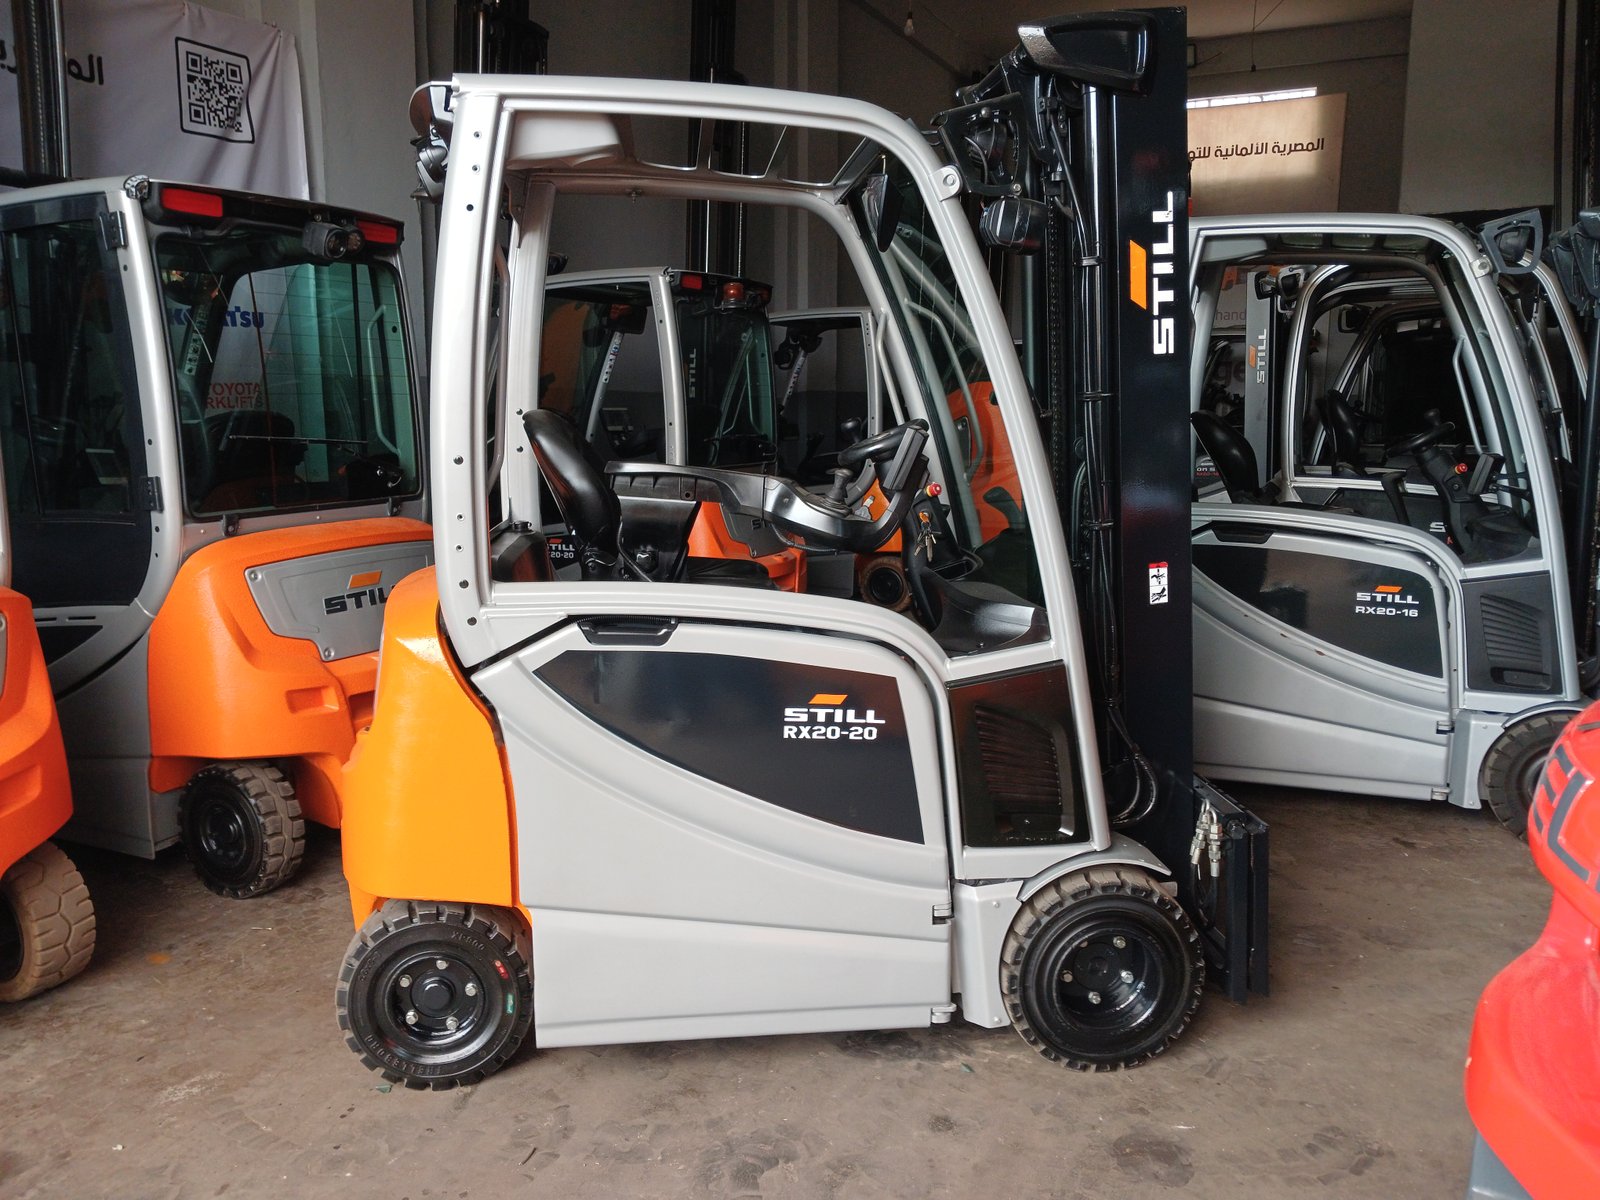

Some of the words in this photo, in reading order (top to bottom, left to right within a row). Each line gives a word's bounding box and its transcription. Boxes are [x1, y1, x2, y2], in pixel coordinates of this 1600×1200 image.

[1187, 146, 1211, 162] للتو
[1214, 142, 1269, 160] الألمانية
[1272, 138, 1325, 156] المصرية
[1152, 191, 1174, 354] STILL
[1257, 328, 1267, 383] STILL
[688, 348, 697, 398] STILL
[209, 382, 264, 396] OYOTA
[206, 396, 265, 409] RKLIFTS
[547, 543, 575, 551] TILL
[549, 551, 574, 559] 20-20
[323, 585, 395, 615] STIL
[1356, 592, 1420, 605] STILL
[1355, 605, 1419, 618] RX20-16
[784, 707, 886, 724] STILL
[783, 725, 878, 740] RX20-20
